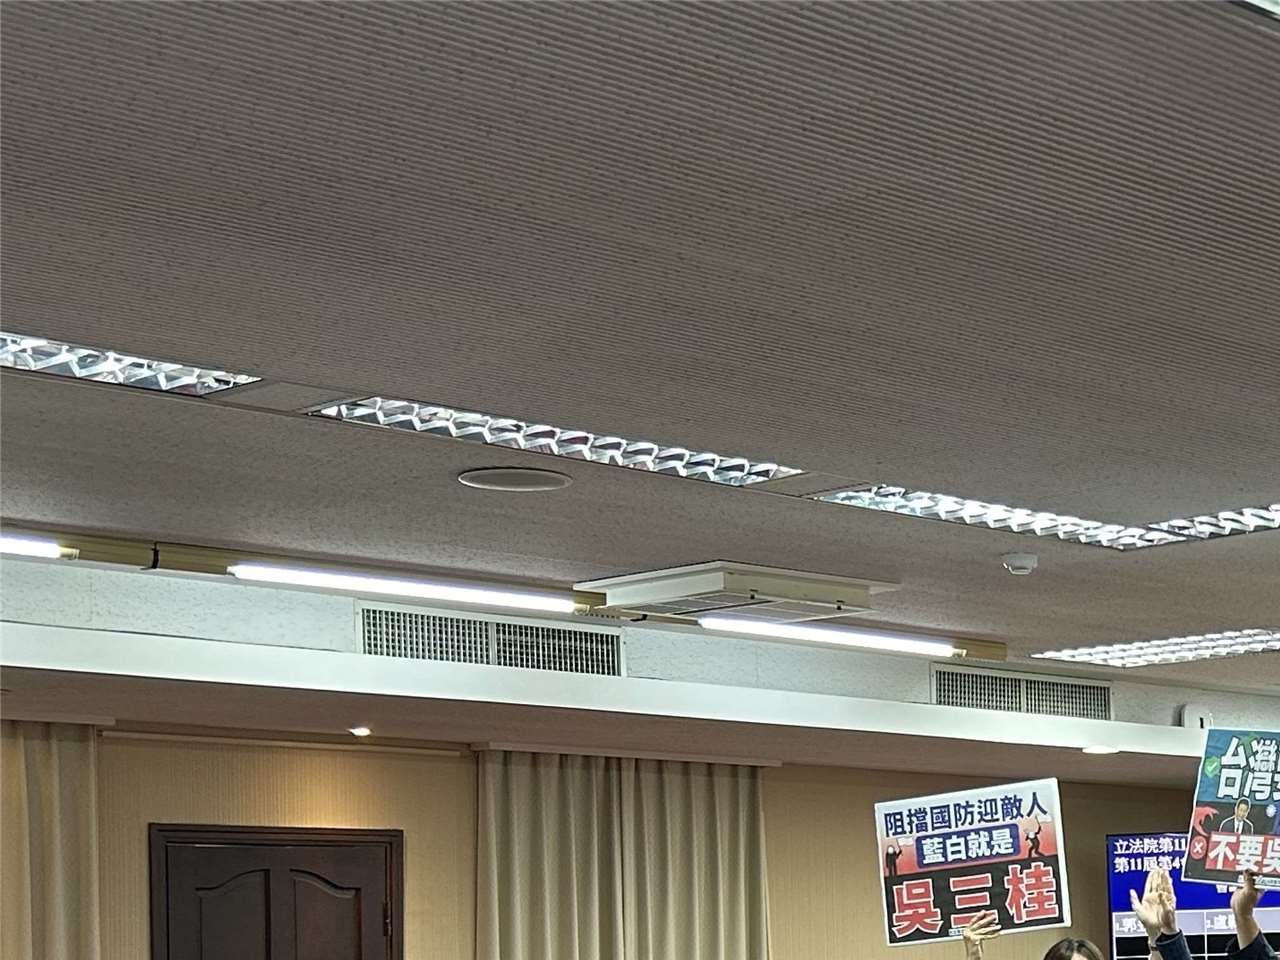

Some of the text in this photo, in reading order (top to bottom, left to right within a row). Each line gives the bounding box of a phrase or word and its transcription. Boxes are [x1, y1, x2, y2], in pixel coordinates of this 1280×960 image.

[884, 792, 1048, 837] 阻擋國防迎敵人
[922, 828, 1014, 865] 藍白就是
[1113, 855, 1186, 873] 第11屆第4
[892, 862, 1059, 938] 吳三桂
